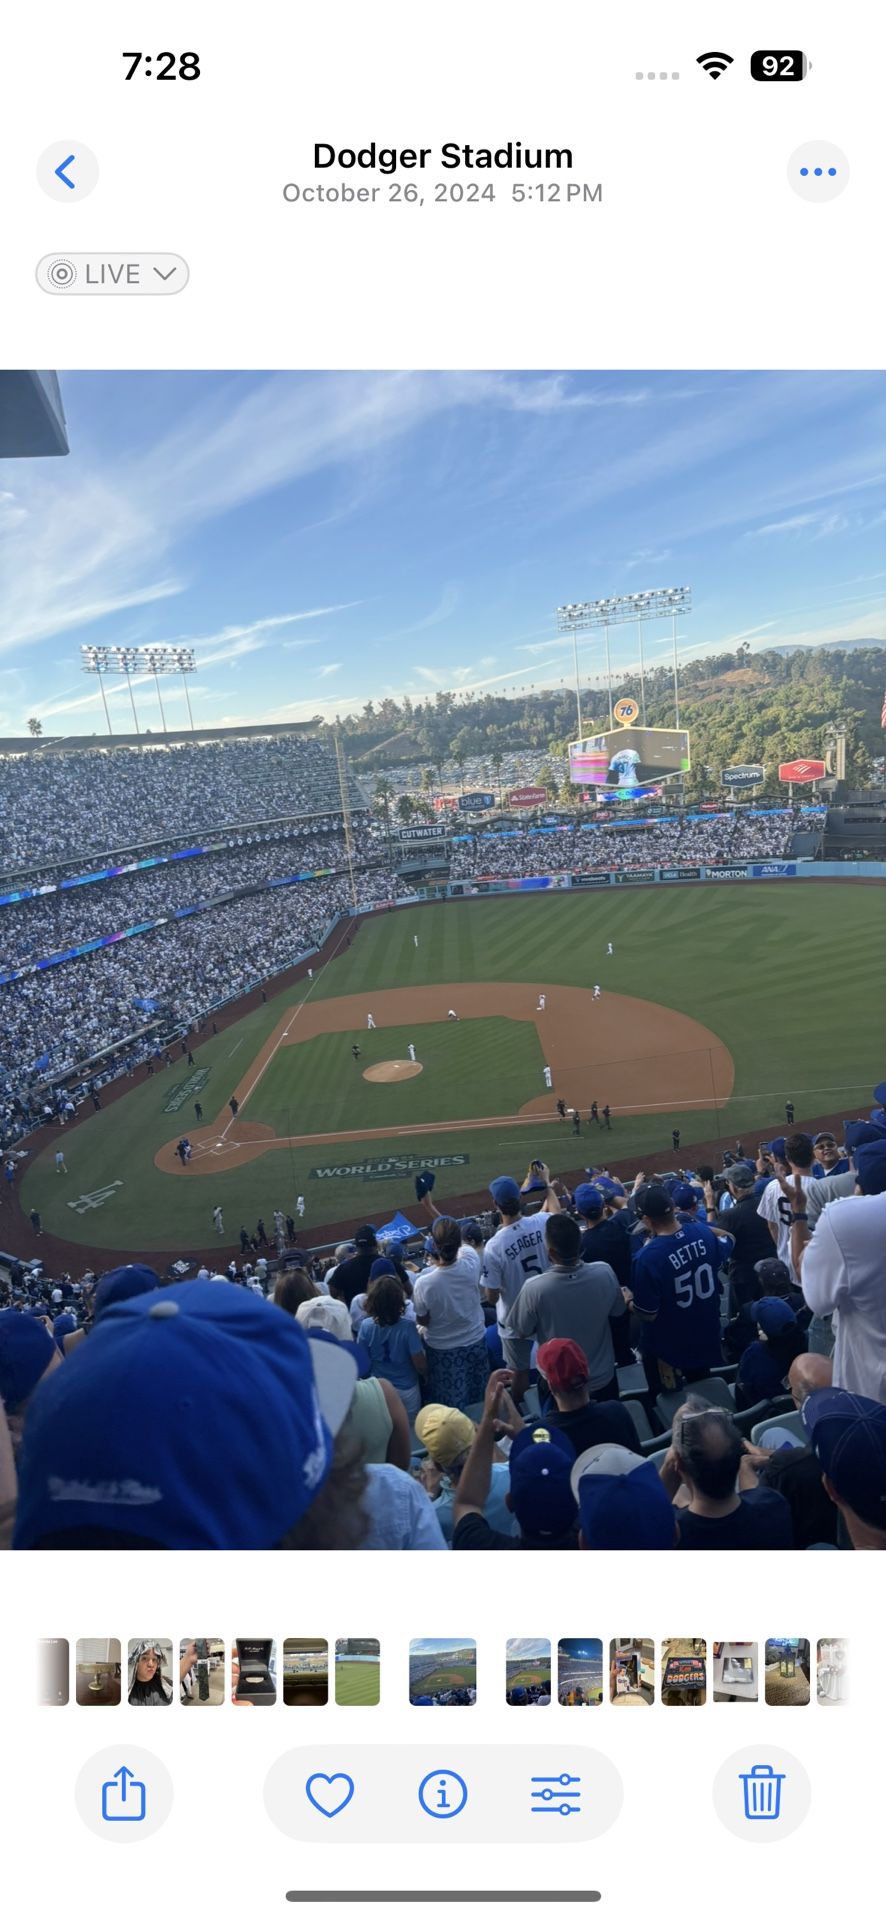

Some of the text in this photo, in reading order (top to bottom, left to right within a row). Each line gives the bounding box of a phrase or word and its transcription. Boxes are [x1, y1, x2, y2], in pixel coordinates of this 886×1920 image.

[620, 704, 633, 716] 76
[724, 772, 758, 781] Spectrum
[461, 797, 482, 807] blue
[401, 827, 443, 839] CUTWATER
[711, 870, 747, 879] MORTON
[761, 865, 779, 873] ANA
[315, 1163, 391, 1178] WORLD
[394, 1155, 465, 1171] SERIES
[504, 1230, 543, 1260] SEAGER
[668, 1239, 707, 1270] BETTS
[520, 1254, 543, 1274] 5
[674, 1262, 715, 1309] 50
